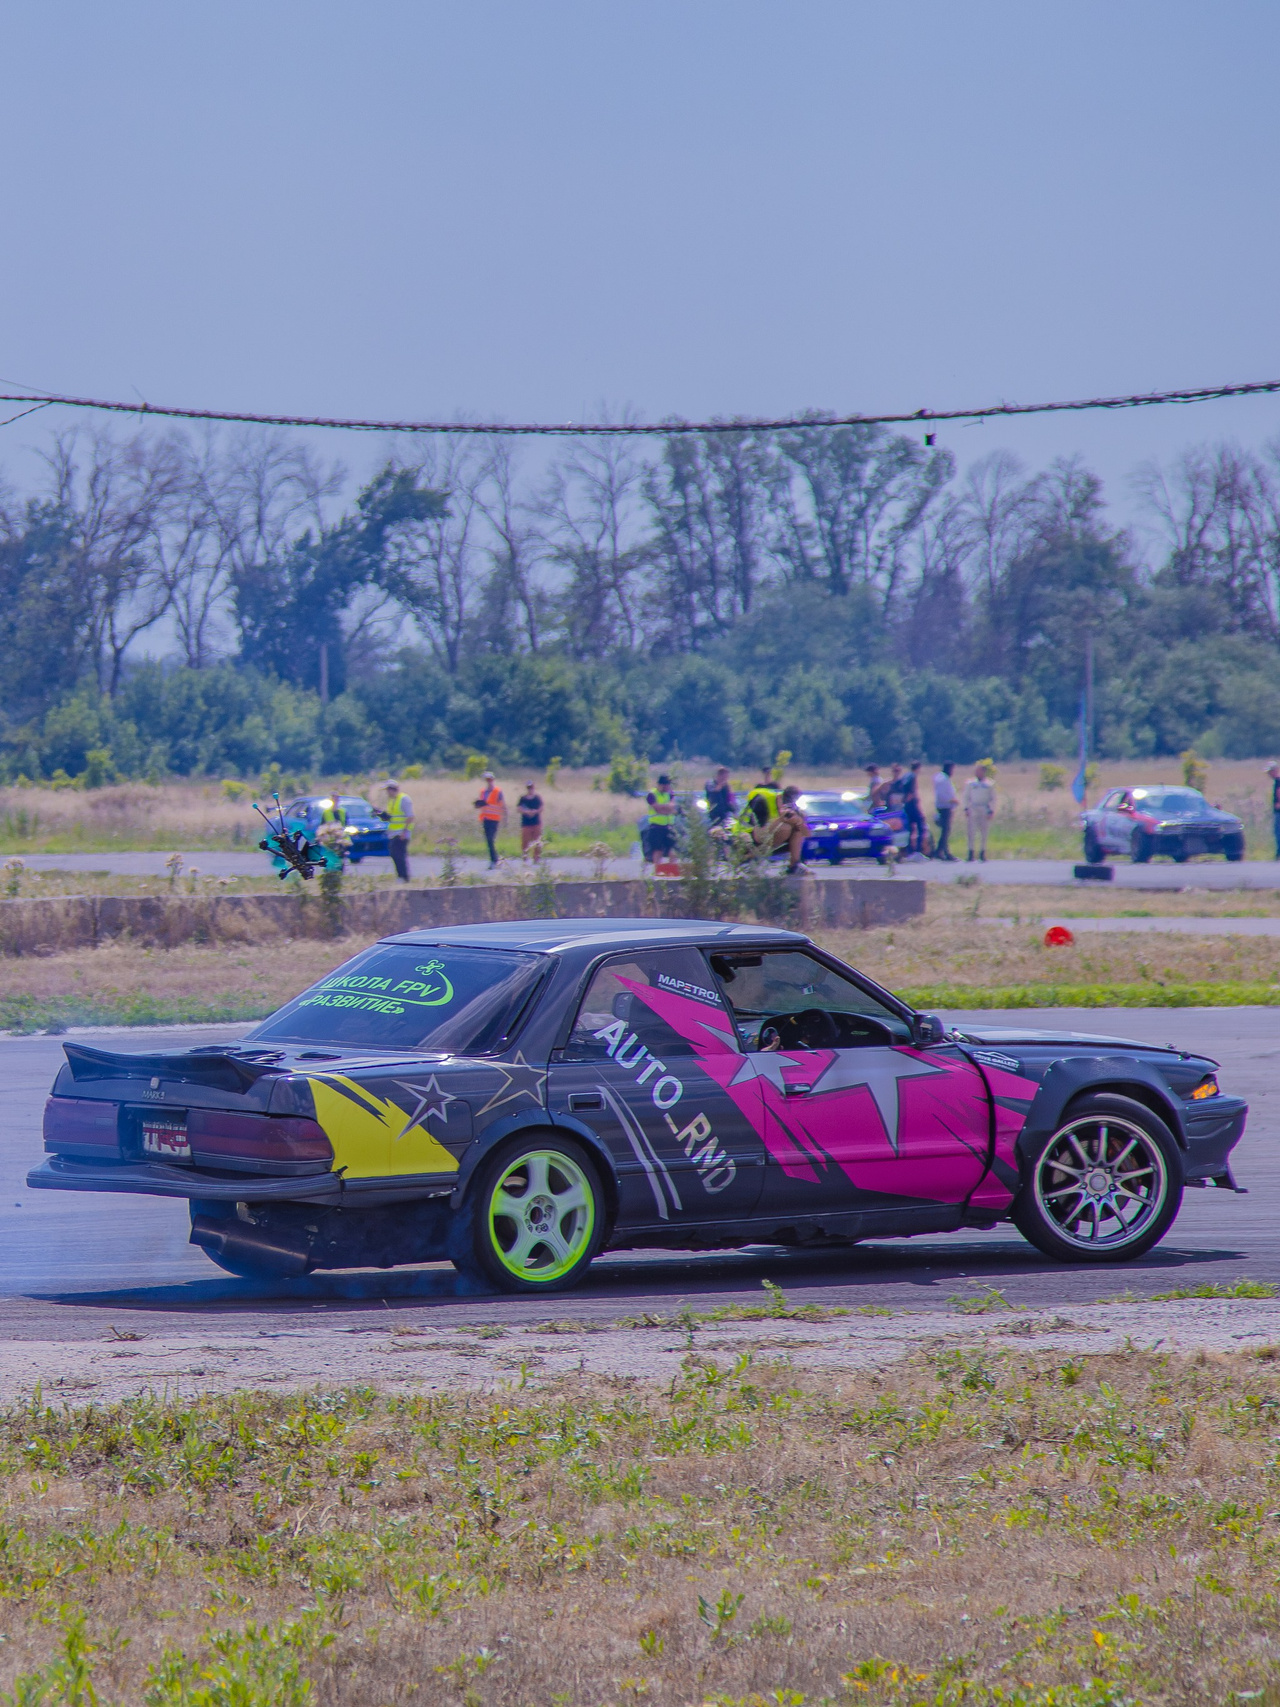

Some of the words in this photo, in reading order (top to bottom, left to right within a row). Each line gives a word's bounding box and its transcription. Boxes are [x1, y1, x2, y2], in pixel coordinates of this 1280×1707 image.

[321, 976, 393, 990] ШКОЛА
[391, 980, 441, 997] FPV
[657, 974, 722, 1003] MAPETROL
